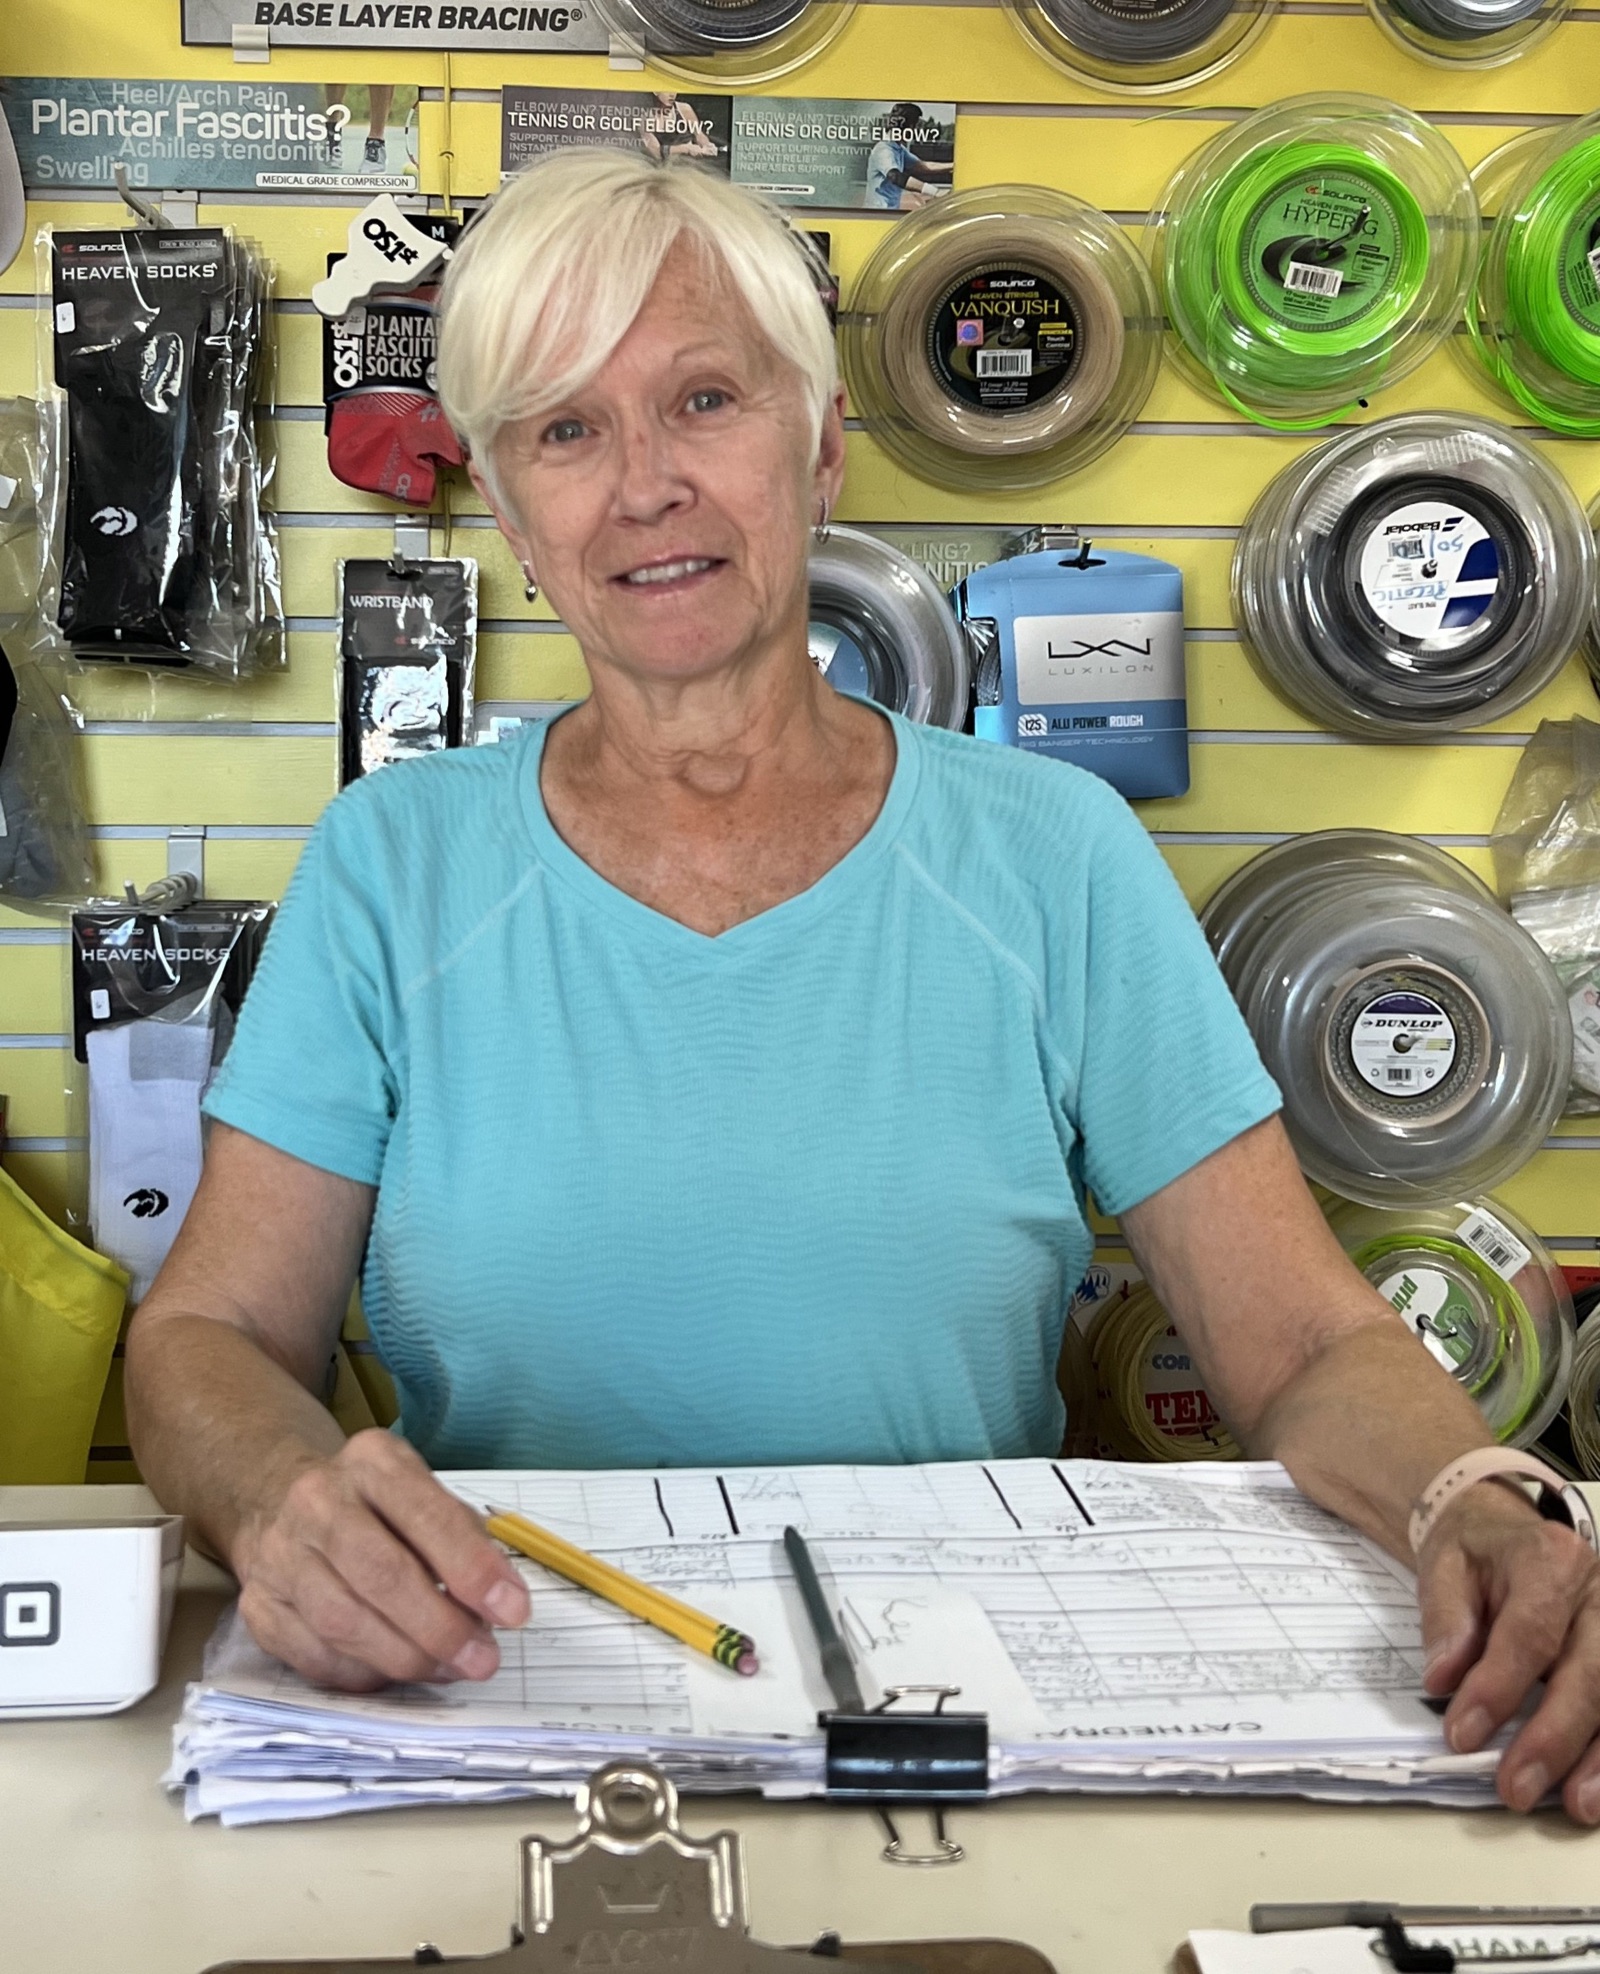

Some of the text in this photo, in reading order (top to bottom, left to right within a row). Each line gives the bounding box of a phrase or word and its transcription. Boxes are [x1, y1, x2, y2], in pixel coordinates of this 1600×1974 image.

[254, 2, 334, 27] BASE
[338, 3, 433, 29] LAYER
[111, 82, 288, 107] Heel/Arch Pain
[514, 101, 558, 114] ELBOW
[560, 102, 597, 116] PAIN?
[32, 98, 352, 142] Plantar Fasciitis?
[507, 112, 714, 135] TENNIS OR GOLF ELBOW?
[742, 110, 906, 128] ELBOW PAIN? TENDONITIS?
[509, 132, 560, 143] SUPPORT
[561, 134, 602, 146] DURING
[735, 121, 940, 143] TENNIS OR GOLF ELBOW?
[118, 136, 343, 163] Achilles tendonitis
[737, 141, 787, 153] SUPPORT
[788, 144, 828, 155] DURING
[737, 152, 818, 164] INSTANT RELIEF
[736, 162, 847, 175] INCREASED SUPPORT
[262, 175, 409, 187] MEDICAL GRADE COMPRESSION
[431, 225, 446, 239] M
[62, 264, 216, 281] HEAVEN SOCKS
[970, 292, 1003, 300] HEAVEN
[950, 299, 1060, 318] VANQUISH
[366, 315, 437, 338] PLANTA
[365, 336, 437, 359] FASCIITI
[365, 356, 423, 379] SOCKS
[910, 543, 972, 560] LING?
[925, 561, 988, 583] NITI
[349, 595, 434, 609] WRISTBAND
[1048, 665, 1154, 676] LUXILON
[1025, 714, 1144, 731] 125 ALU POWER ROUGH
[81, 948, 231, 961] HEAVEN SOCKS
[1375, 1019, 1444, 1029] DUNLOP
[1035, 1721, 1263, 1741] CATHEDRA
